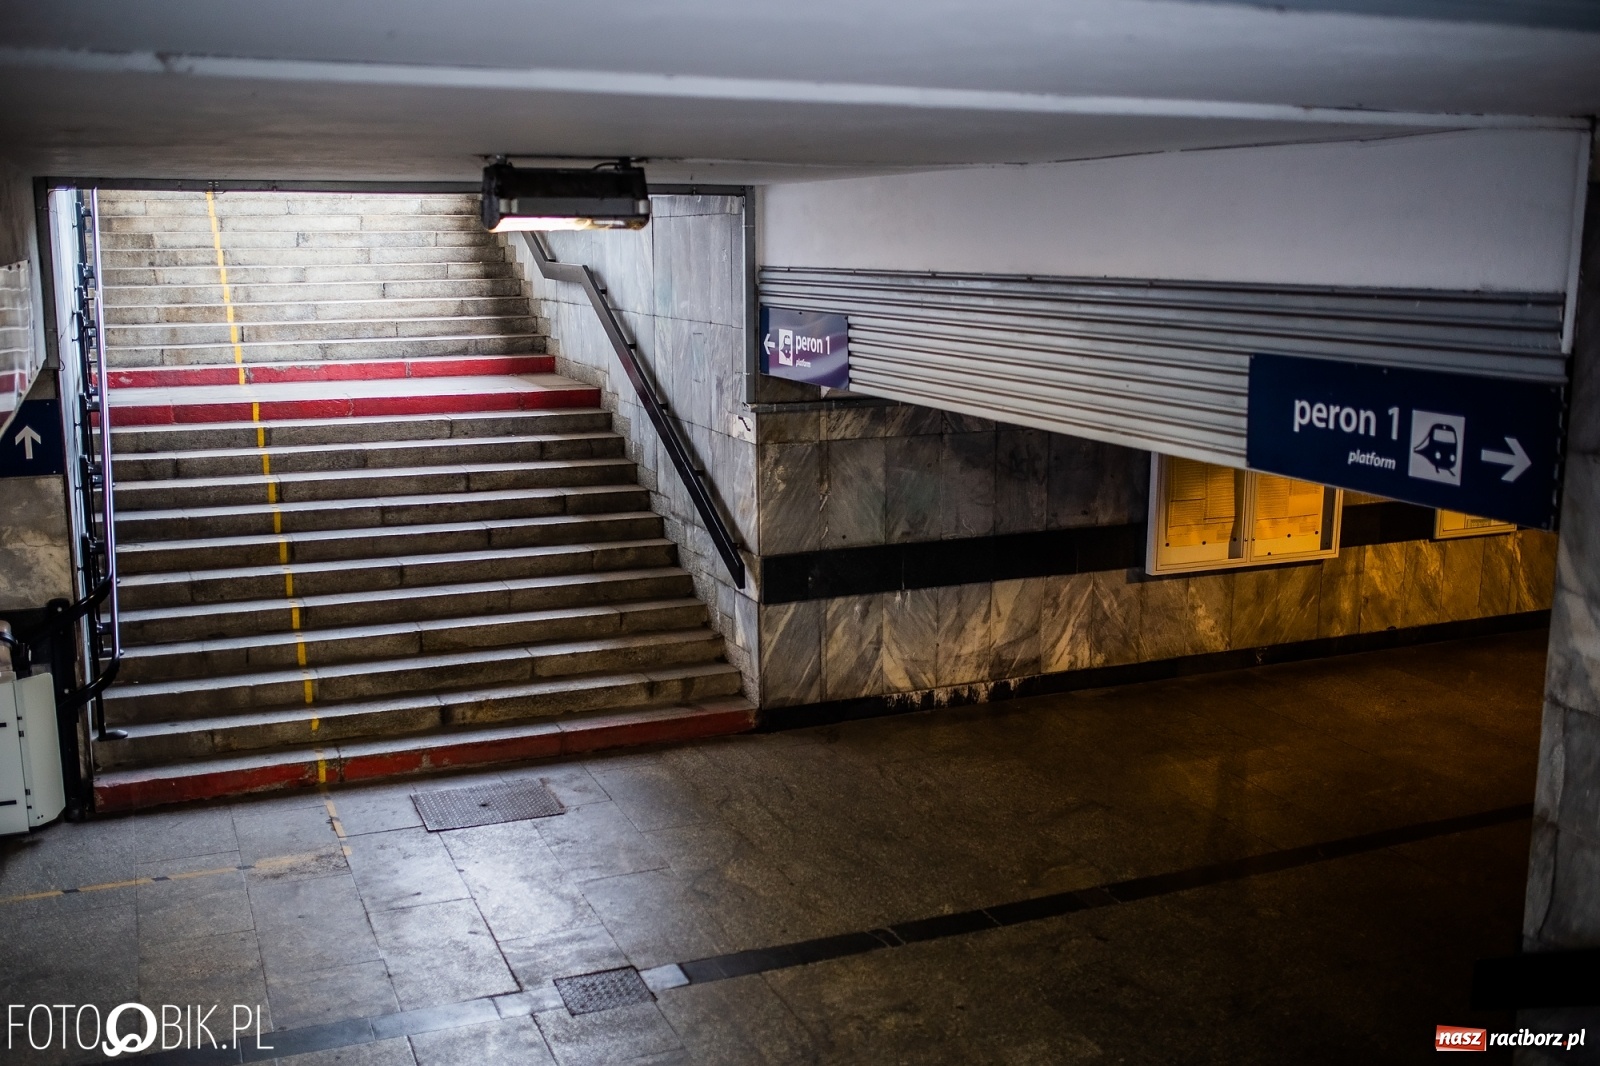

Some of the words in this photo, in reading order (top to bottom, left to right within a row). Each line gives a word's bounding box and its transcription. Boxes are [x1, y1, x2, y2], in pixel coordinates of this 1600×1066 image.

[795, 335, 823, 354] peron
[825, 335, 831, 355] 1
[1293, 398, 1377, 436] peron
[1388, 406, 1400, 440] 1
[1347, 449, 1396, 470] platform
